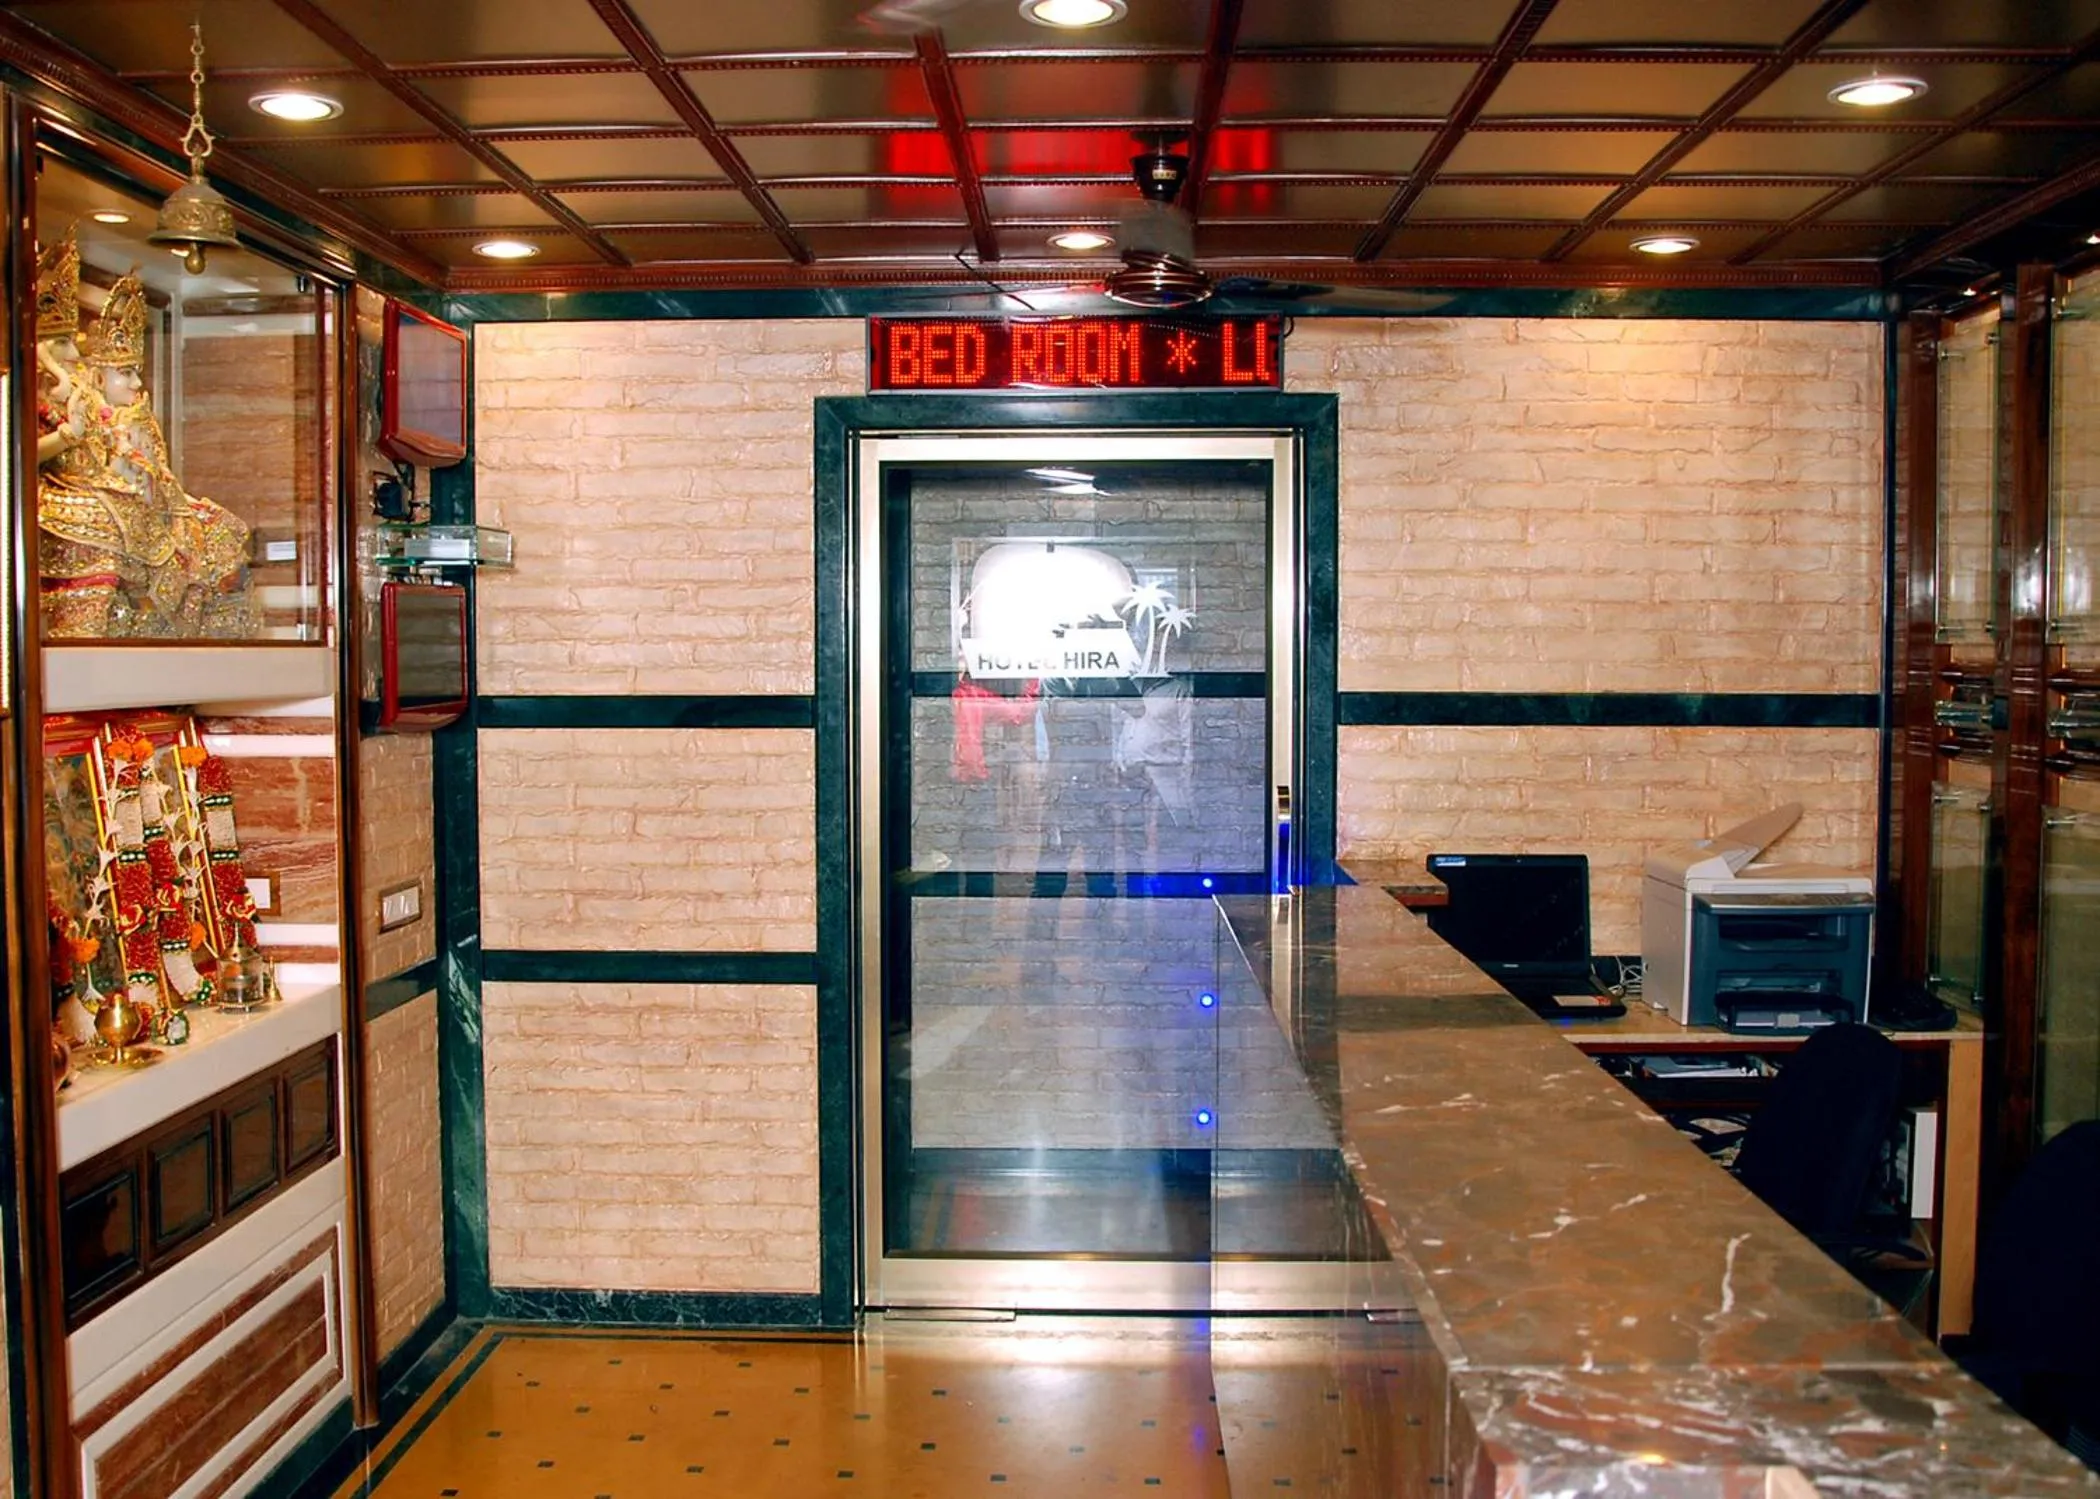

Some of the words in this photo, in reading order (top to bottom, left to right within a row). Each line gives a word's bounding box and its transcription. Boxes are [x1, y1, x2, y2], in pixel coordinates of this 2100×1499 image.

[890, 324, 985, 384] BED
[1012, 323, 1140, 383] ROOM
[1063, 650, 1121, 670] HIRA
